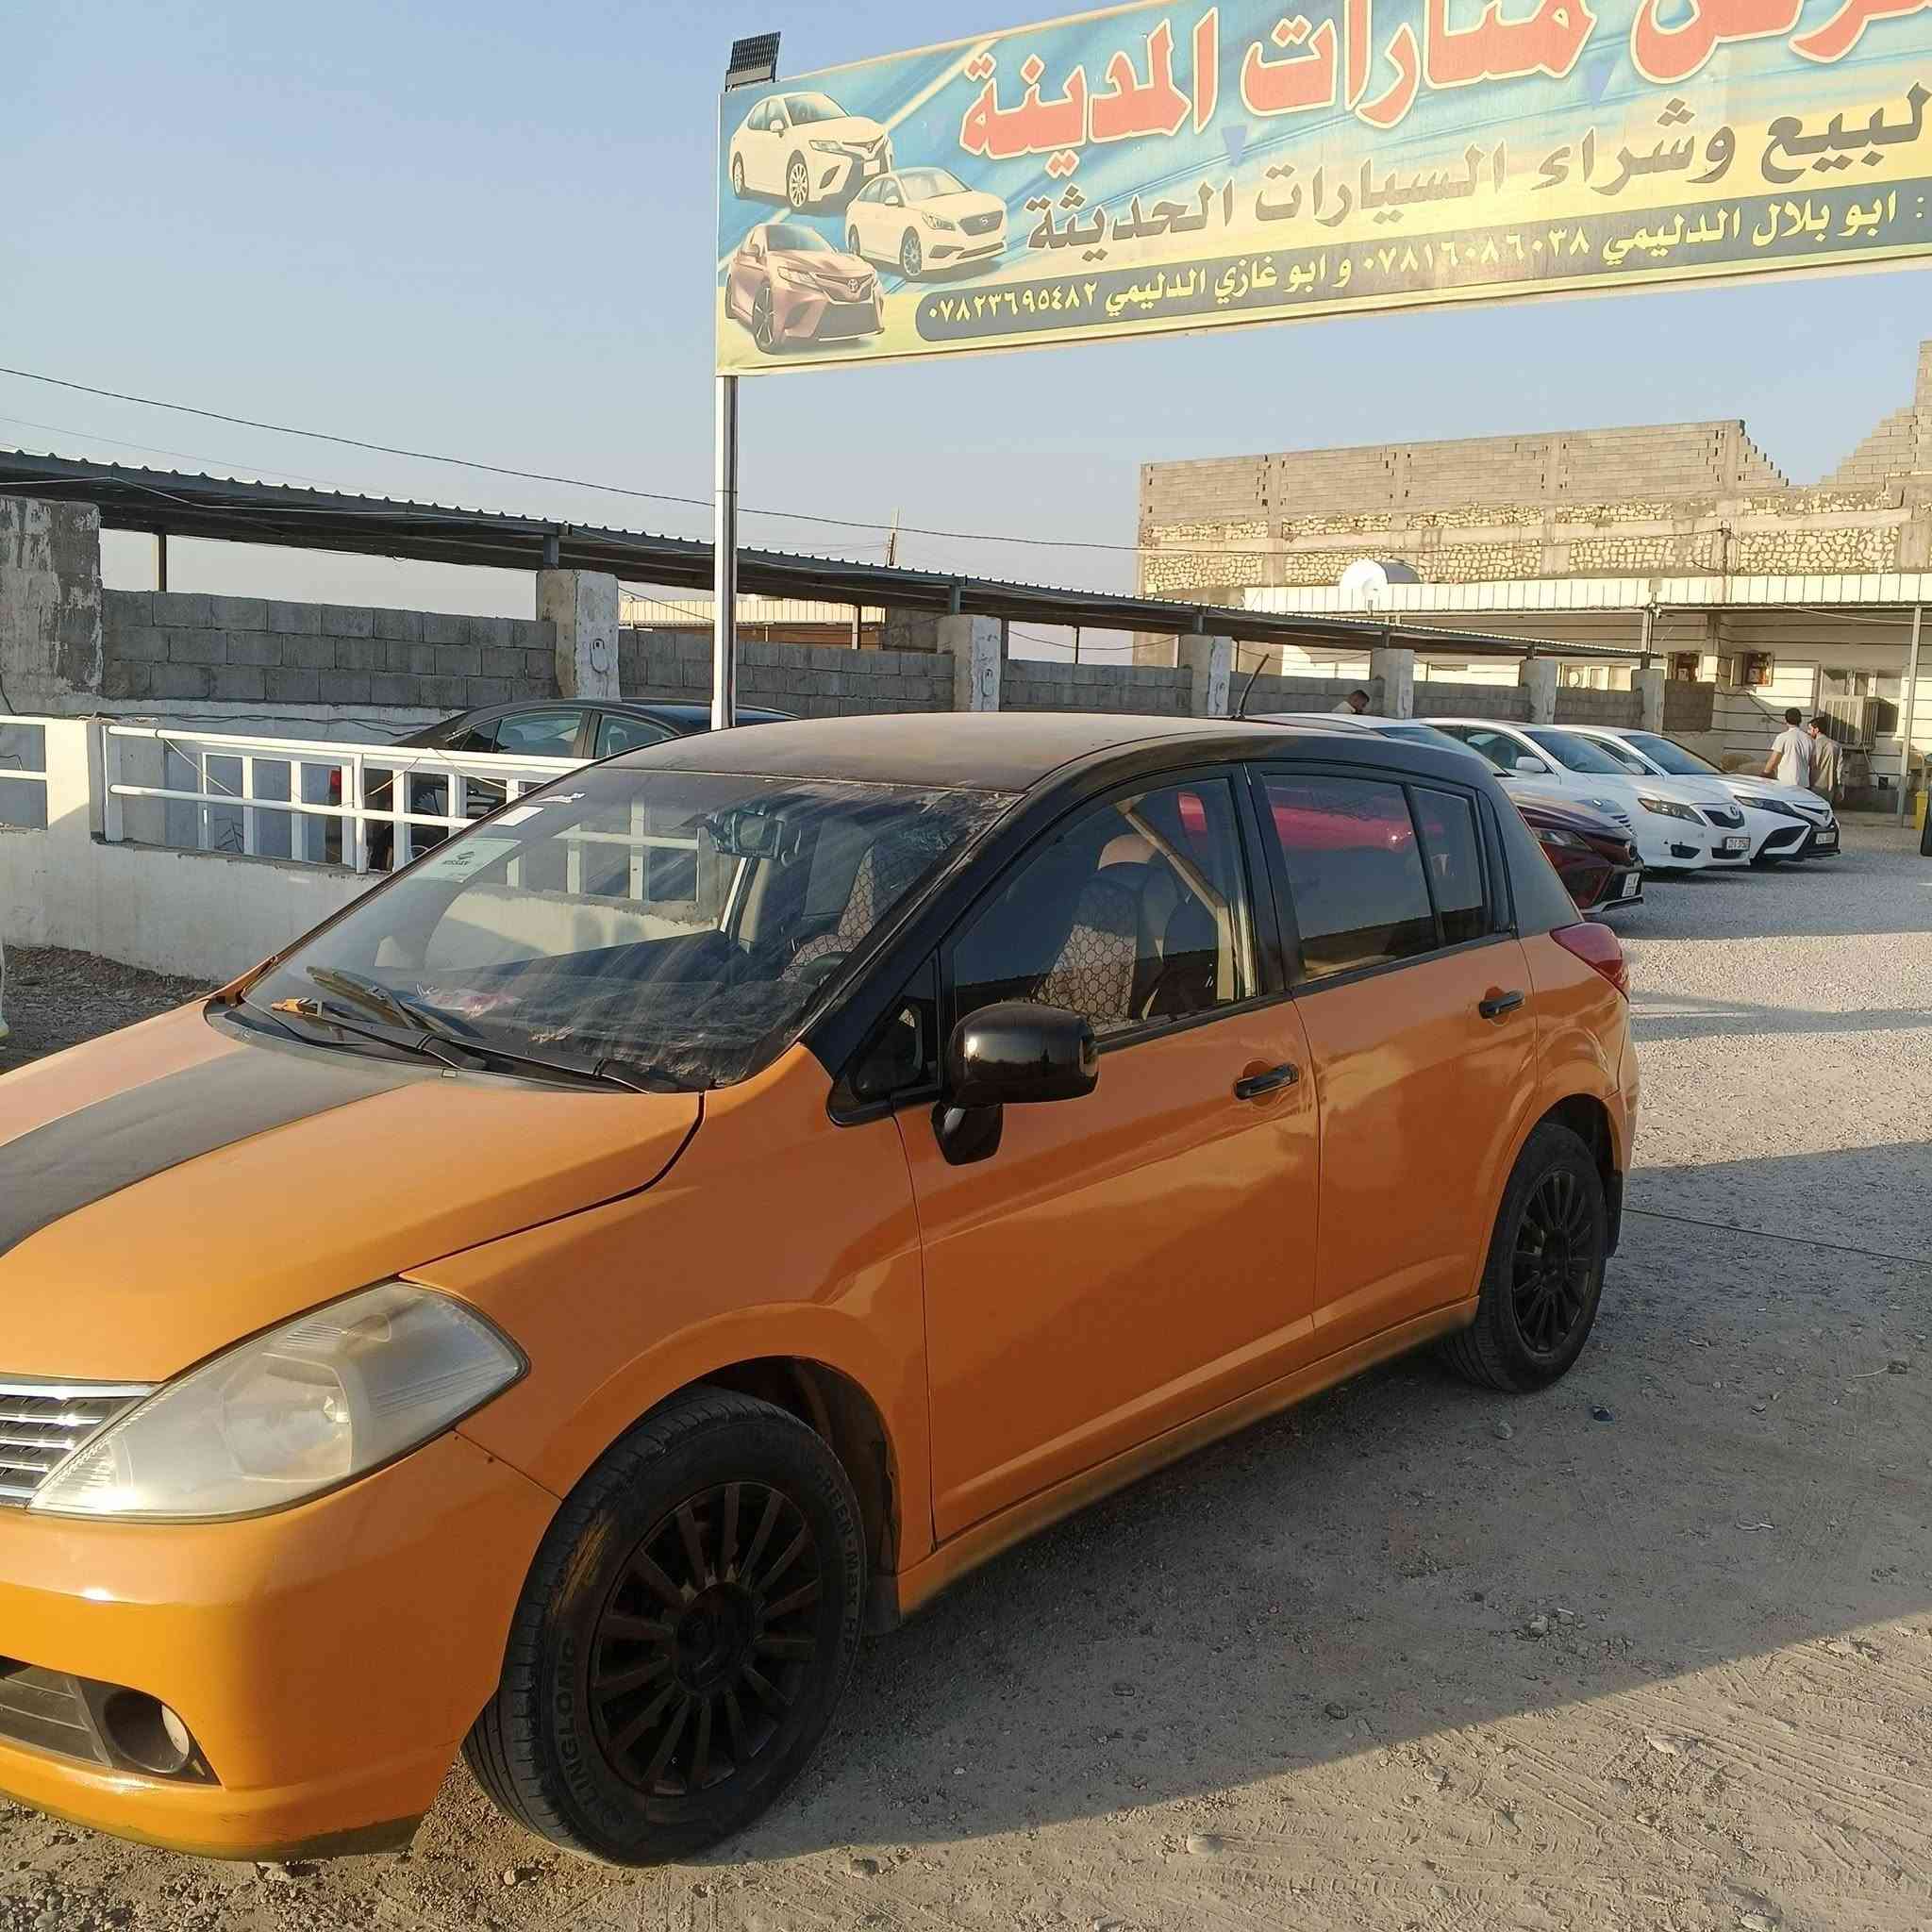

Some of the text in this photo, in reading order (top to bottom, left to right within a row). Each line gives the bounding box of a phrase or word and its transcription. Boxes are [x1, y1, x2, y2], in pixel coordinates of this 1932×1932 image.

[959, 8, 1218, 177] المدينة
[1531, 97, 1736, 195] وشراء
[1255, 142, 1507, 226] السيارات
[1025, 179, 1235, 263] الحديثة
[1602, 207, 1742, 265] الدليمي
[1752, 197, 1831, 247] بلال
[1838, 190, 1897, 237] ابو
[1363, 225, 1591, 274] ٠٧٨١٦٠٨٦٠٣٨
[1105, 267, 1208, 317] الدليمي
[1214, 256, 1278, 304] غازي
